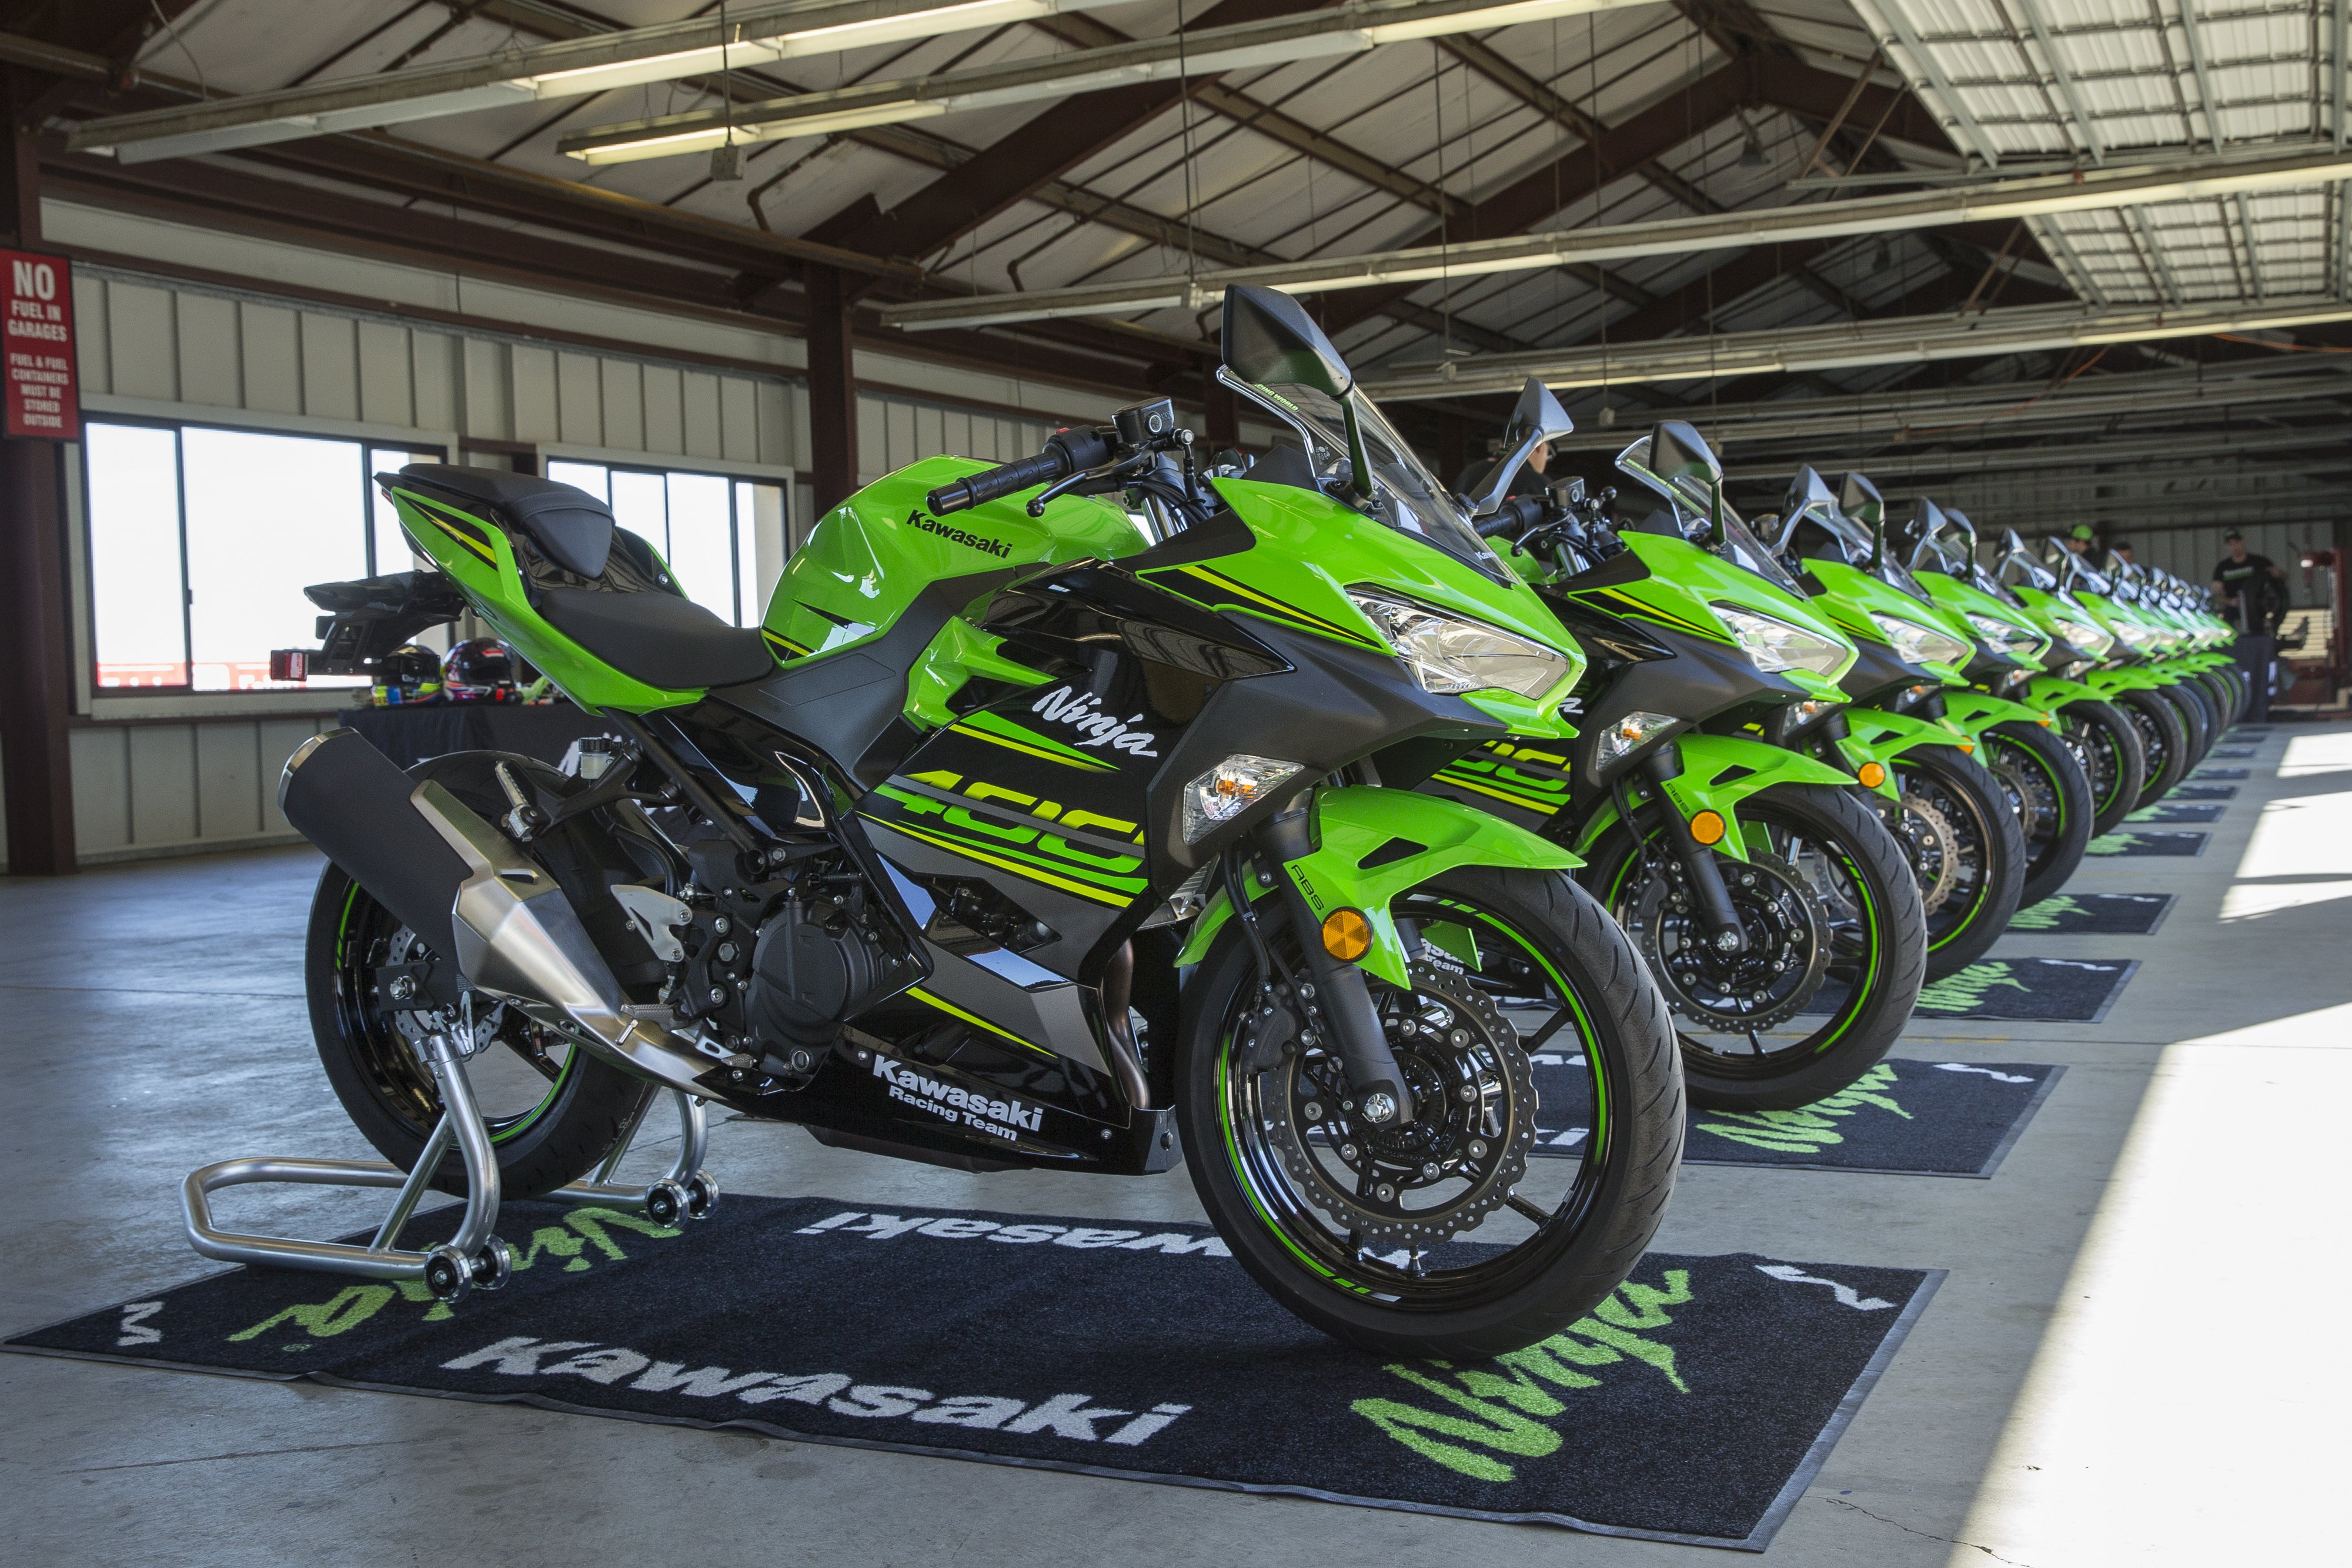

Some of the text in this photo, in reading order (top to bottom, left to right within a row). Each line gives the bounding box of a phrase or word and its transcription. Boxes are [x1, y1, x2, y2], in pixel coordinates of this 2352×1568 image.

[13, 260, 55, 301] NO
[8, 319, 67, 342] GARAGES
[11, 299, 61, 322] FUEL IN
[9, 352, 34, 367] FUEL
[45, 356, 69, 370] FUEL
[11, 367, 69, 385] CONTAINERS
[1272, 393, 1299, 411] WORLD
[906, 509, 1013, 559] Kawasaki
[1032, 686, 1158, 757] Ninja
[874, 770, 1145, 873] 400
[1291, 864, 1324, 910] ABS
[873, 1054, 1043, 1132] Kawasaki
[889, 1085, 1017, 1141] Racing Team
[794, 1212, 1232, 1257] wasaki
[439, 1336, 1194, 1447] Kawasaki
[1351, 1269, 1694, 1482] Ninja
